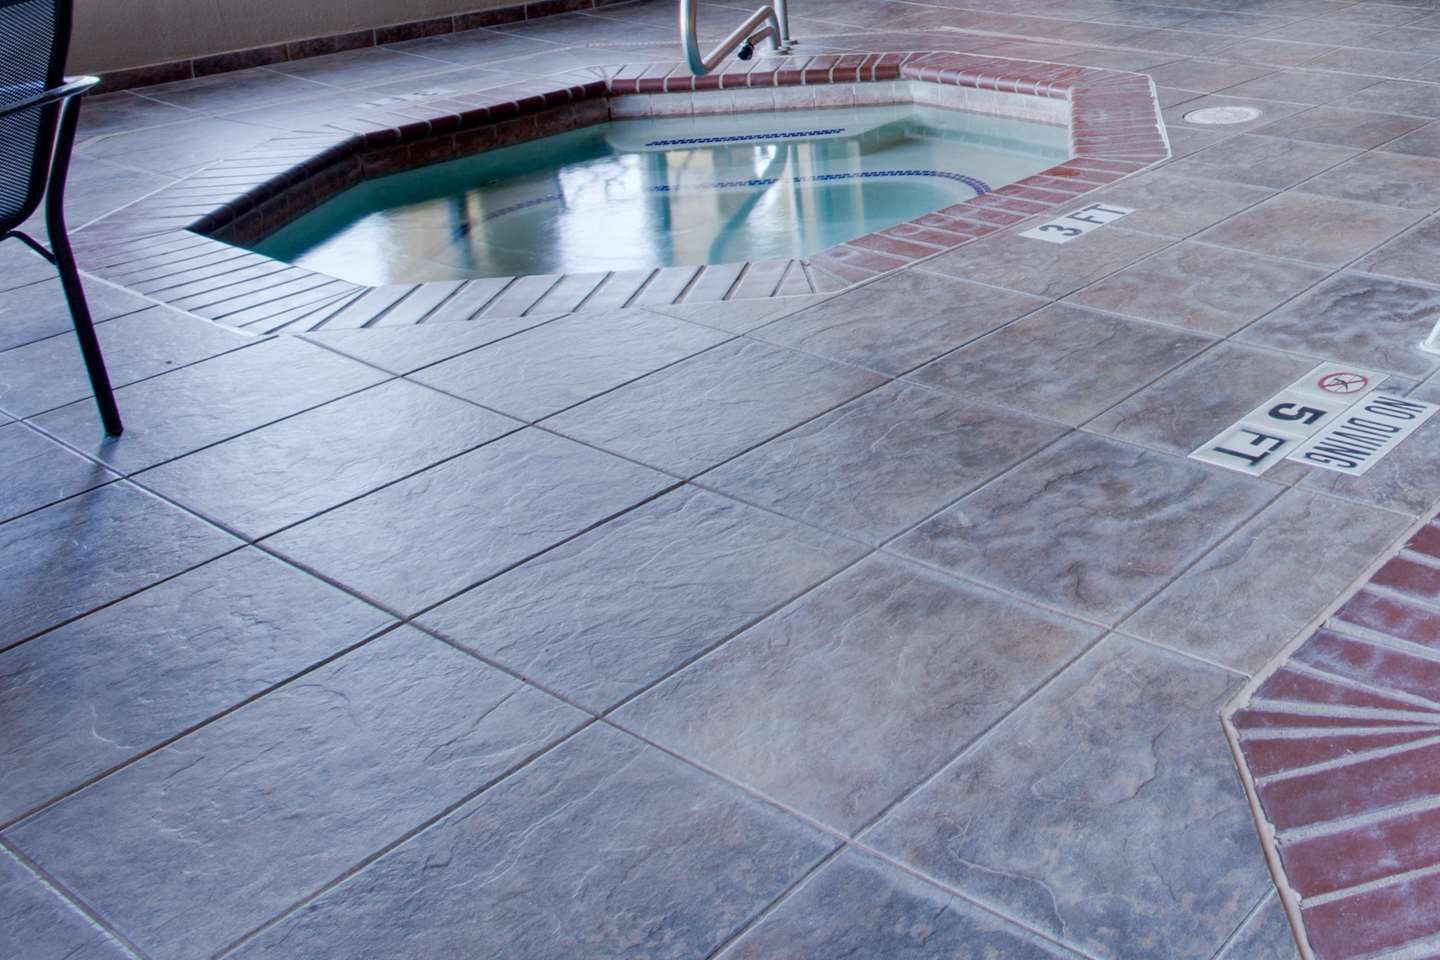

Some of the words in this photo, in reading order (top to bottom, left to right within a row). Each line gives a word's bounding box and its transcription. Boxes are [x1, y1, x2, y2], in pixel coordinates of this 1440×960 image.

[1039, 224, 1082, 236] 3
[1065, 204, 1126, 224] FT
[1268, 403, 1327, 425] 5
[1365, 396, 1428, 420] NO
[1213, 429, 1287, 467] FT
[1303, 417, 1404, 469] DIVING
